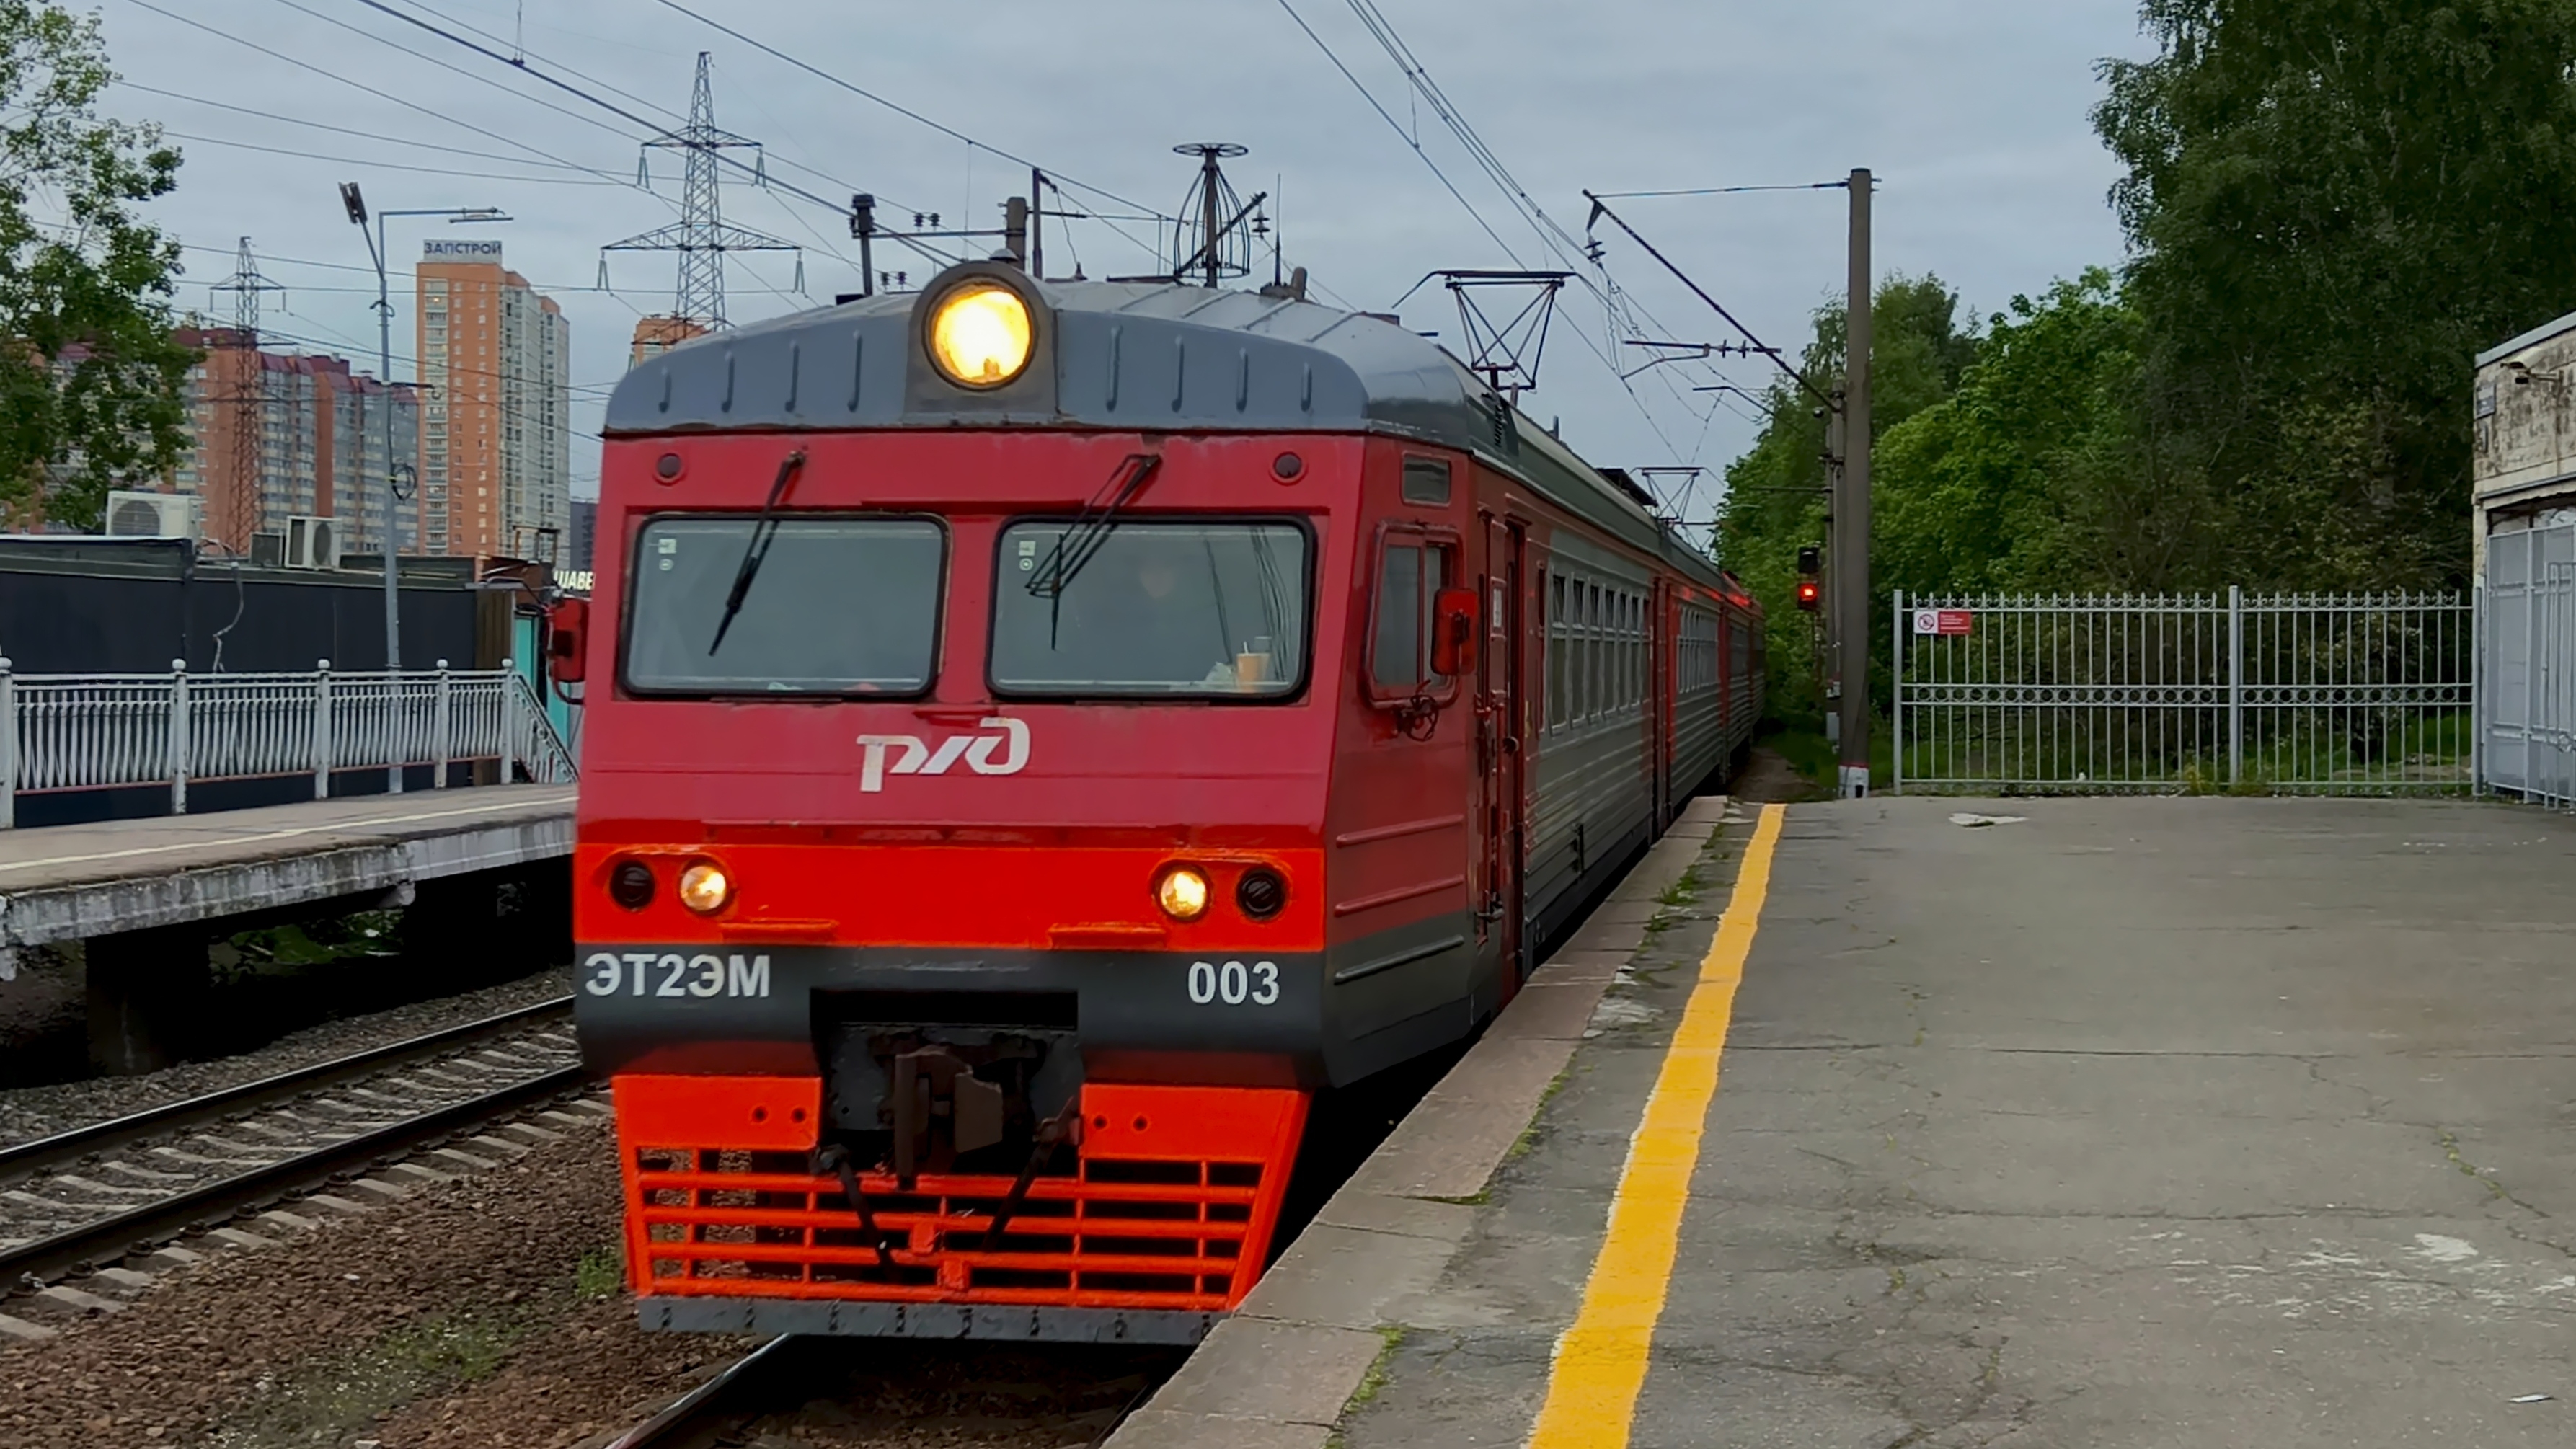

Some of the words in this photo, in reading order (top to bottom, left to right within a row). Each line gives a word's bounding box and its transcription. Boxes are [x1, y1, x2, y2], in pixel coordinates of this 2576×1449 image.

[857, 717, 1030, 792] РЖД
[584, 952, 771, 998] ЭТ2ЭМ
[1188, 960, 1280, 1005] 003
